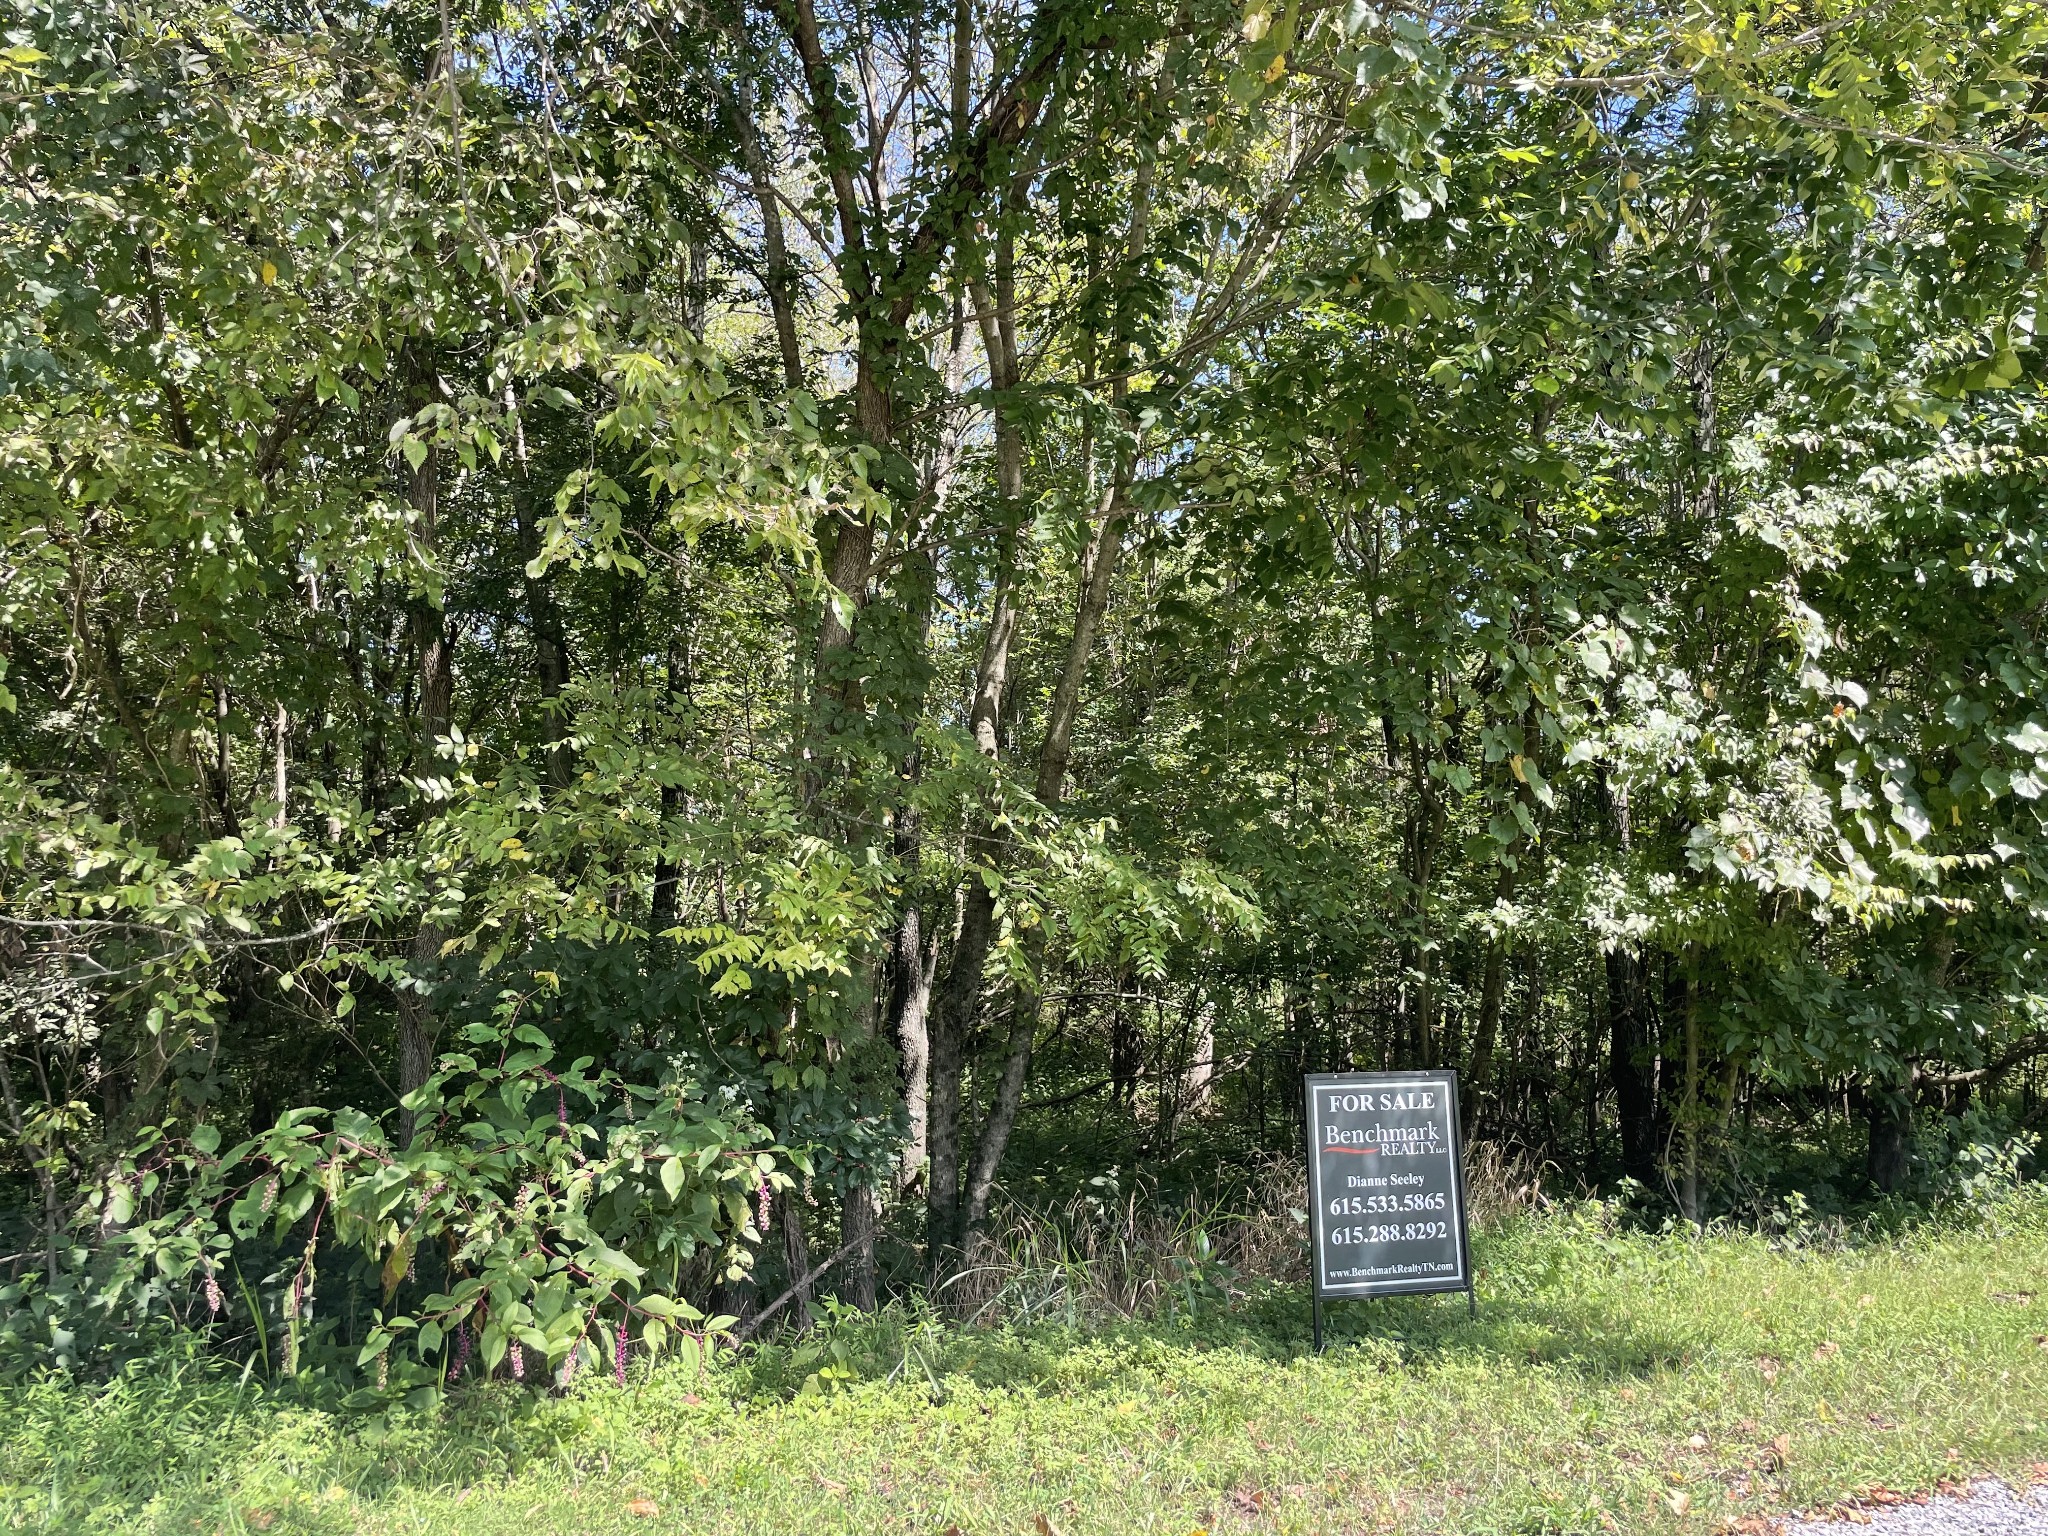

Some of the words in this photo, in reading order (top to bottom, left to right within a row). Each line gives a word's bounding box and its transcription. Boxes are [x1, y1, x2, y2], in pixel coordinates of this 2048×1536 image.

[1329, 1094, 1375, 1112] FOR
[1380, 1092, 1435, 1111] SALE
[1325, 1121, 1440, 1145] Benchmark
[1381, 1141, 1436, 1156] REALTY
[1347, 1175, 1387, 1188] Dianne
[1390, 1173, 1425, 1187] Seeley
[1330, 1192, 1445, 1216] 615.533.5865
[1331, 1221, 1447, 1245] 615.288.8292
[1329, 1262, 1453, 1278] www.BenchmarkRealtyTN.com
